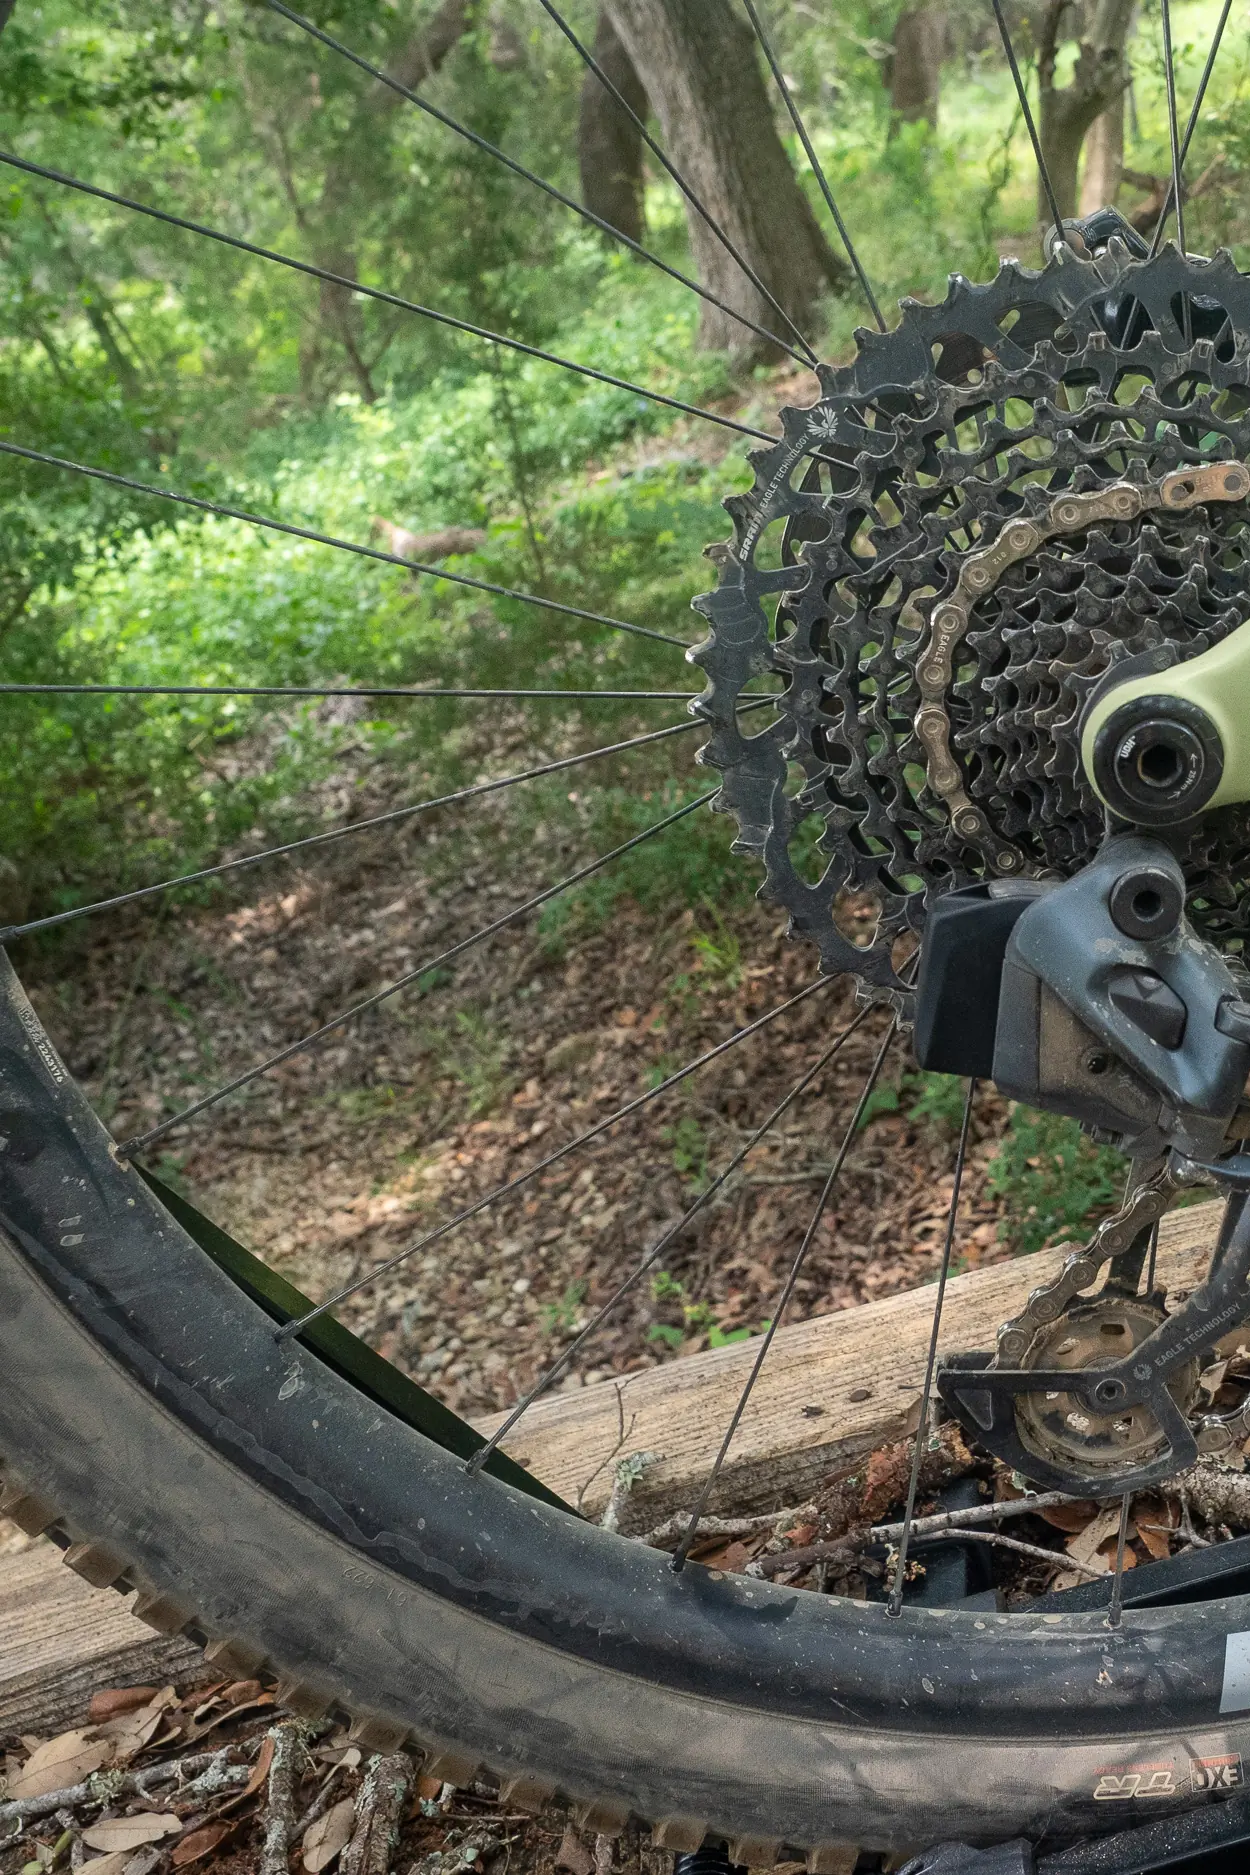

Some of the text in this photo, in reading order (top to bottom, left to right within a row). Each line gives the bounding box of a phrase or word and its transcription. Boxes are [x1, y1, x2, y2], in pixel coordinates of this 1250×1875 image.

[760, 481, 779, 509] EAGLE
[773, 433, 810, 482] TECHNOLOGY
[934, 634, 950, 664] EAGLE
[1154, 1302, 1241, 1367] EAGLE TECHNOLOGY
[1093, 1771, 1176, 1800] TR
